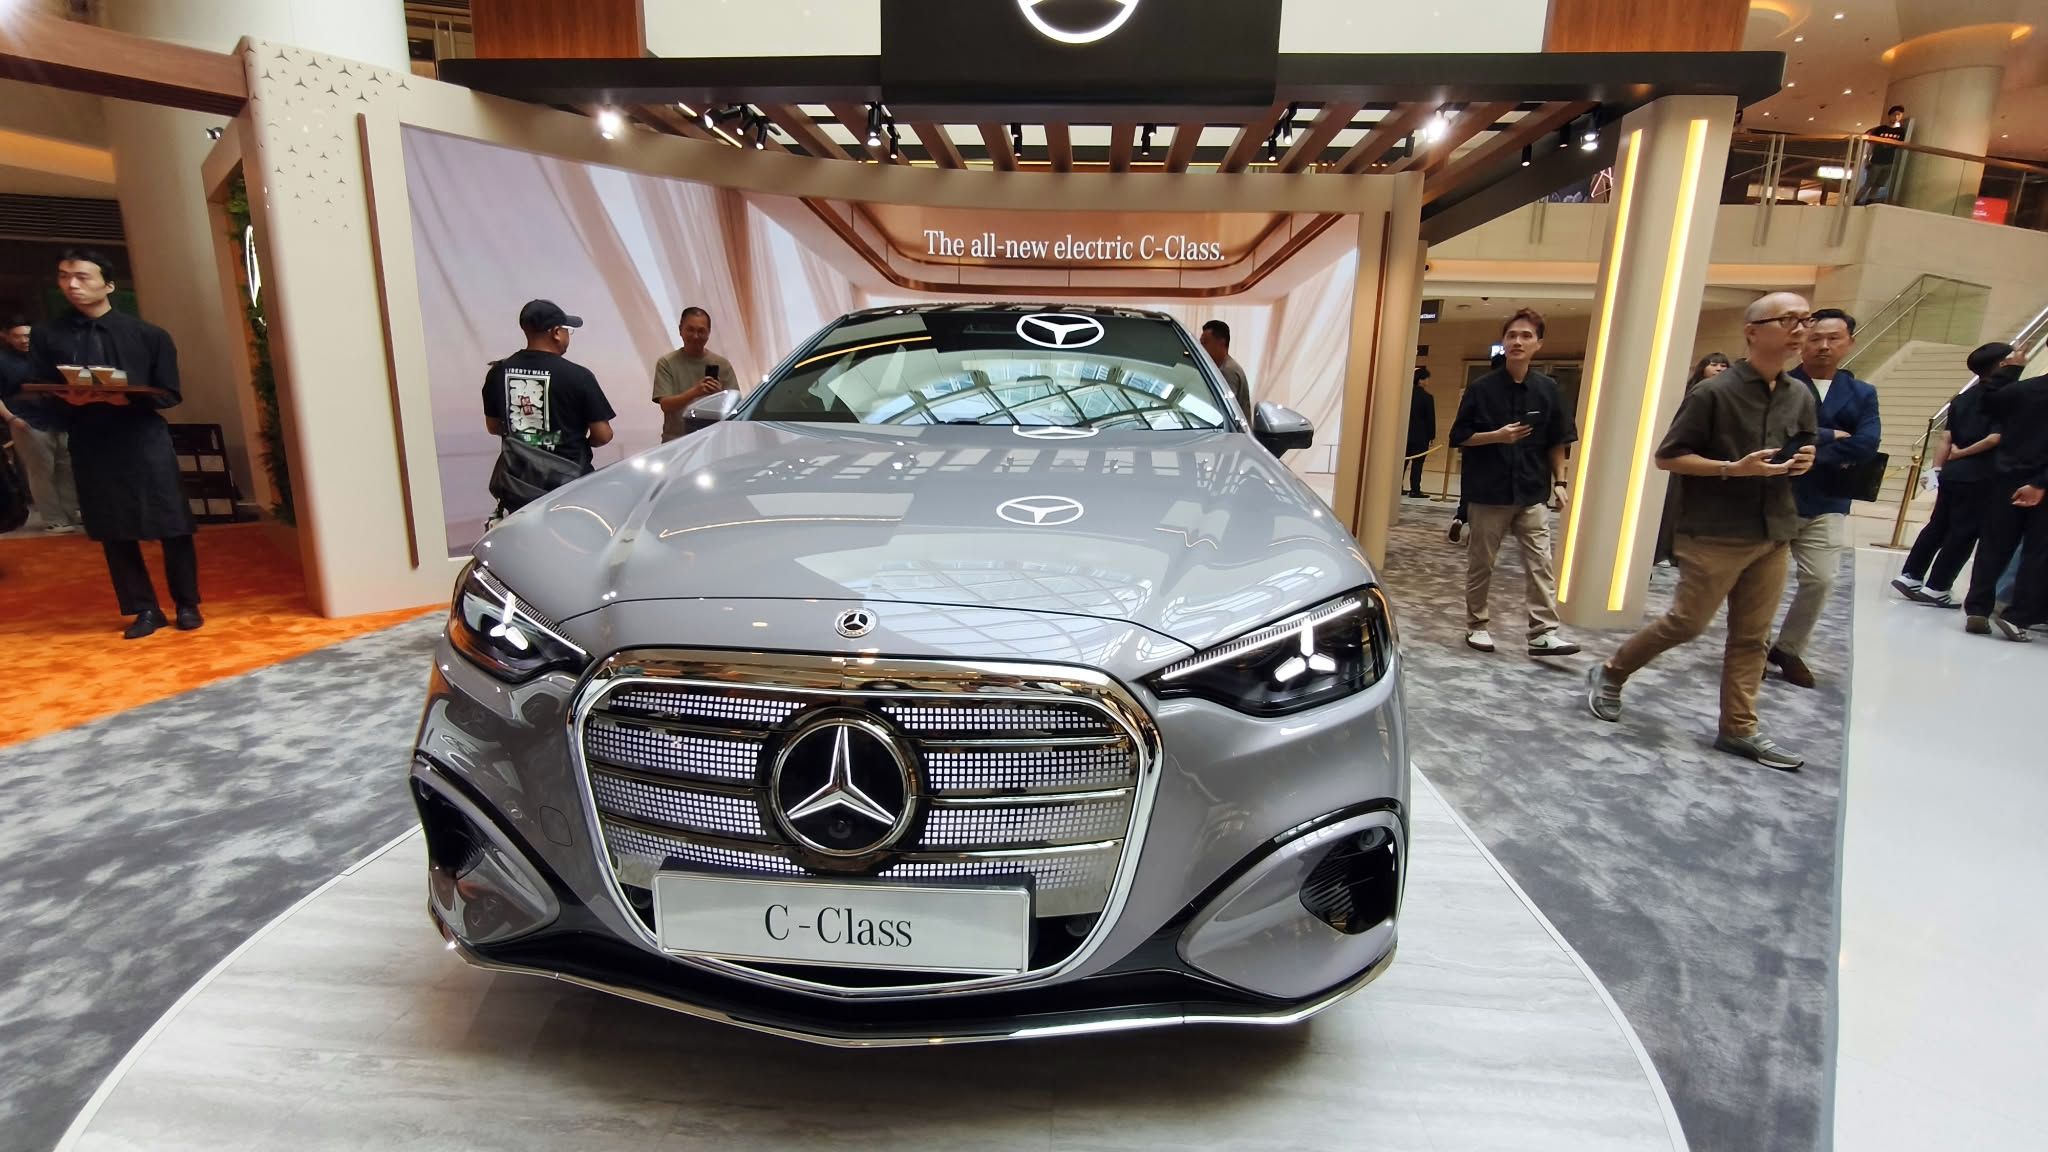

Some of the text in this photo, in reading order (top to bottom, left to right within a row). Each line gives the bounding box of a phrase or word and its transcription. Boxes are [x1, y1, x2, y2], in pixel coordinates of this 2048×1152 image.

[923, 229, 1226, 261] The all-new electric C-Class.
